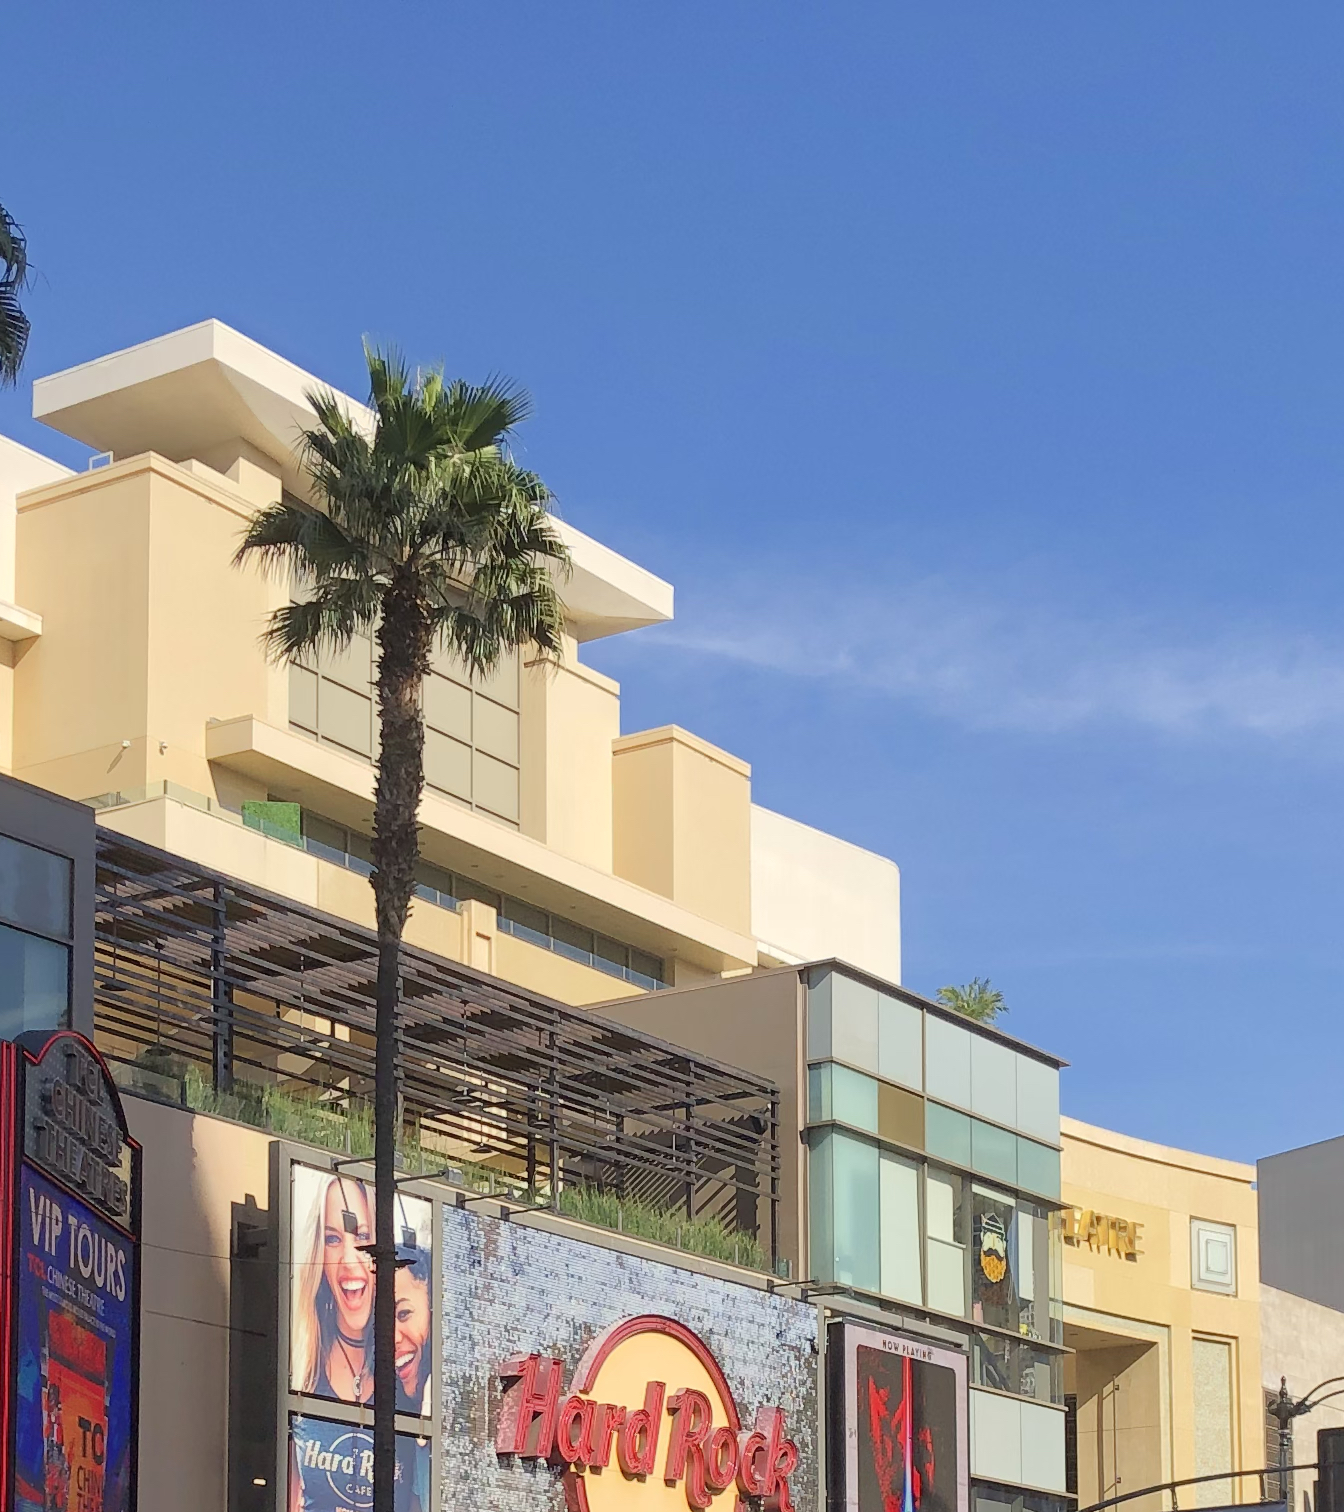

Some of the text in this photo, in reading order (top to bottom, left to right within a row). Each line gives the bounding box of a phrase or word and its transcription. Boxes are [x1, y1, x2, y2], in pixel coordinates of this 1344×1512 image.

[51, 1077, 123, 1167] CHINESE
[37, 1119, 128, 1216] THEATRES
[29, 1187, 126, 1302] VIP TOURS
[47, 1265, 76, 1299] CHINESE
[882, 1339, 933, 1361] NOW PLAYING
[497, 1354, 665, 1478] Hard
[304, 1440, 358, 1475] Hard
[345, 1484, 372, 1497] CAFE
